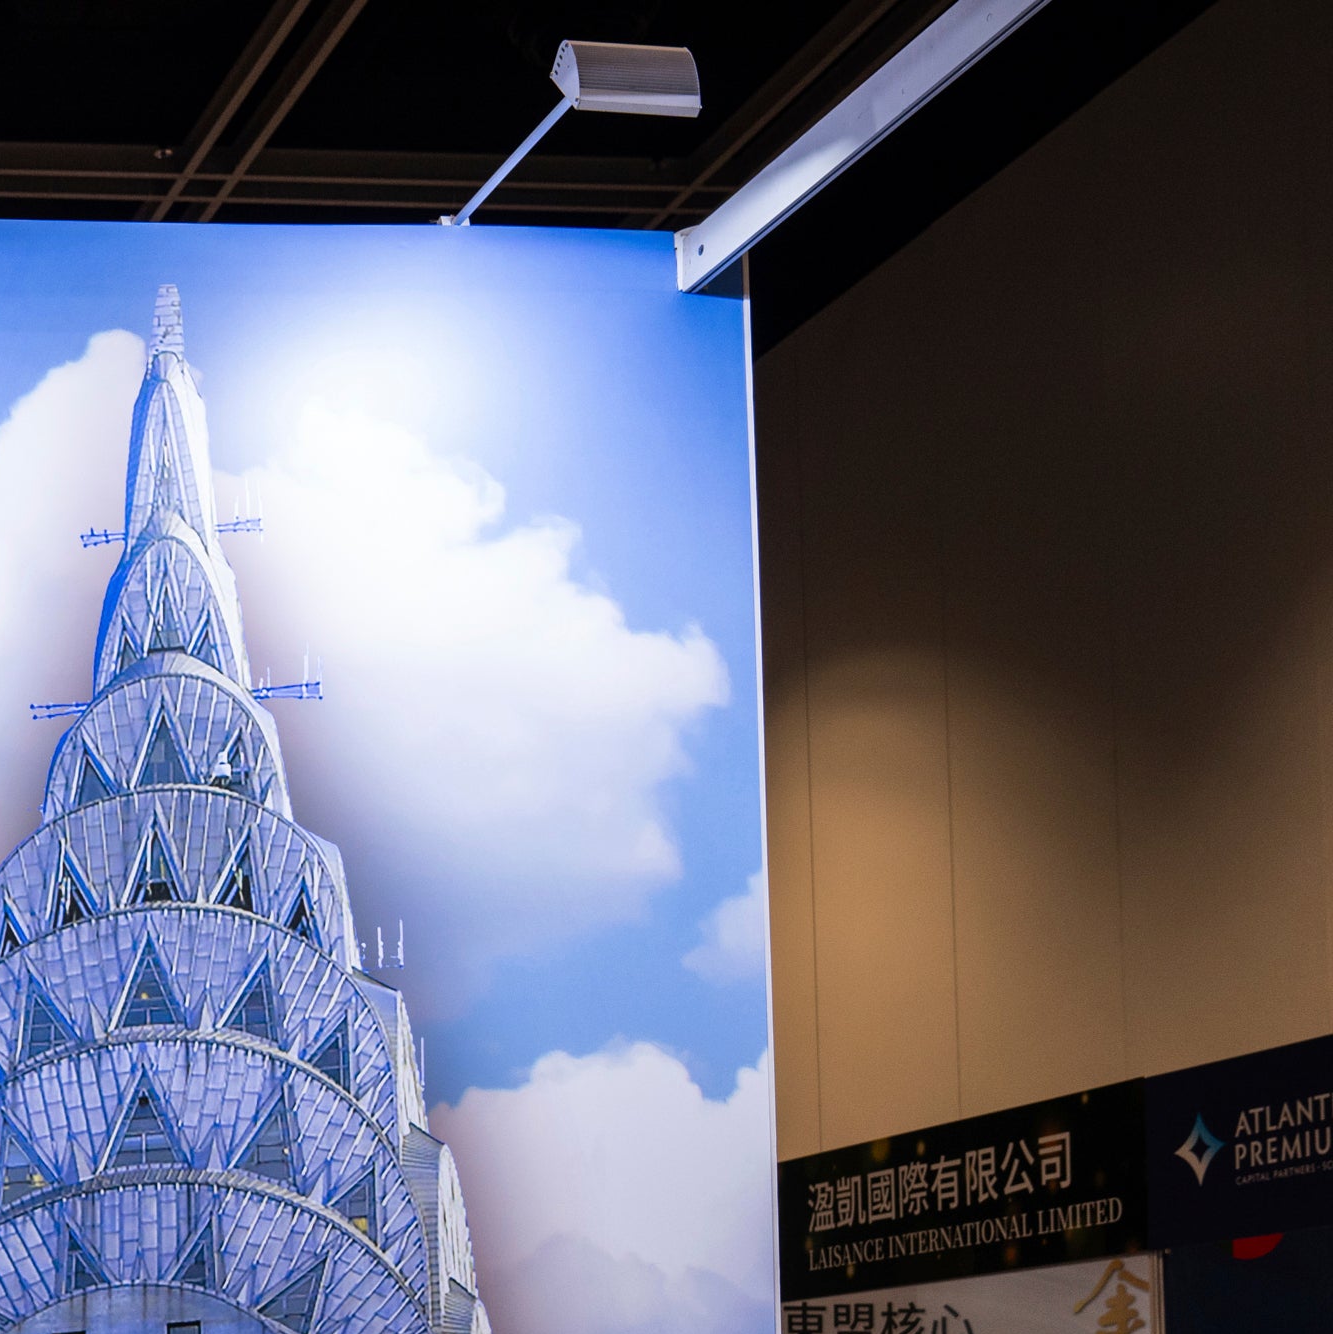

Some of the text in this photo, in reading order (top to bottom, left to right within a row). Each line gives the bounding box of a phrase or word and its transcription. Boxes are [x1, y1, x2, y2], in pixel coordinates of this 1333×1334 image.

[1234, 1092, 1333, 1137] ATLANT
[1235, 1171, 1271, 1186] CAPITAL
[1273, 1163, 1316, 1179] PARTNERS
[809, 1196, 1123, 1272] LAISANCE INTERNATIONAL LIMITED
